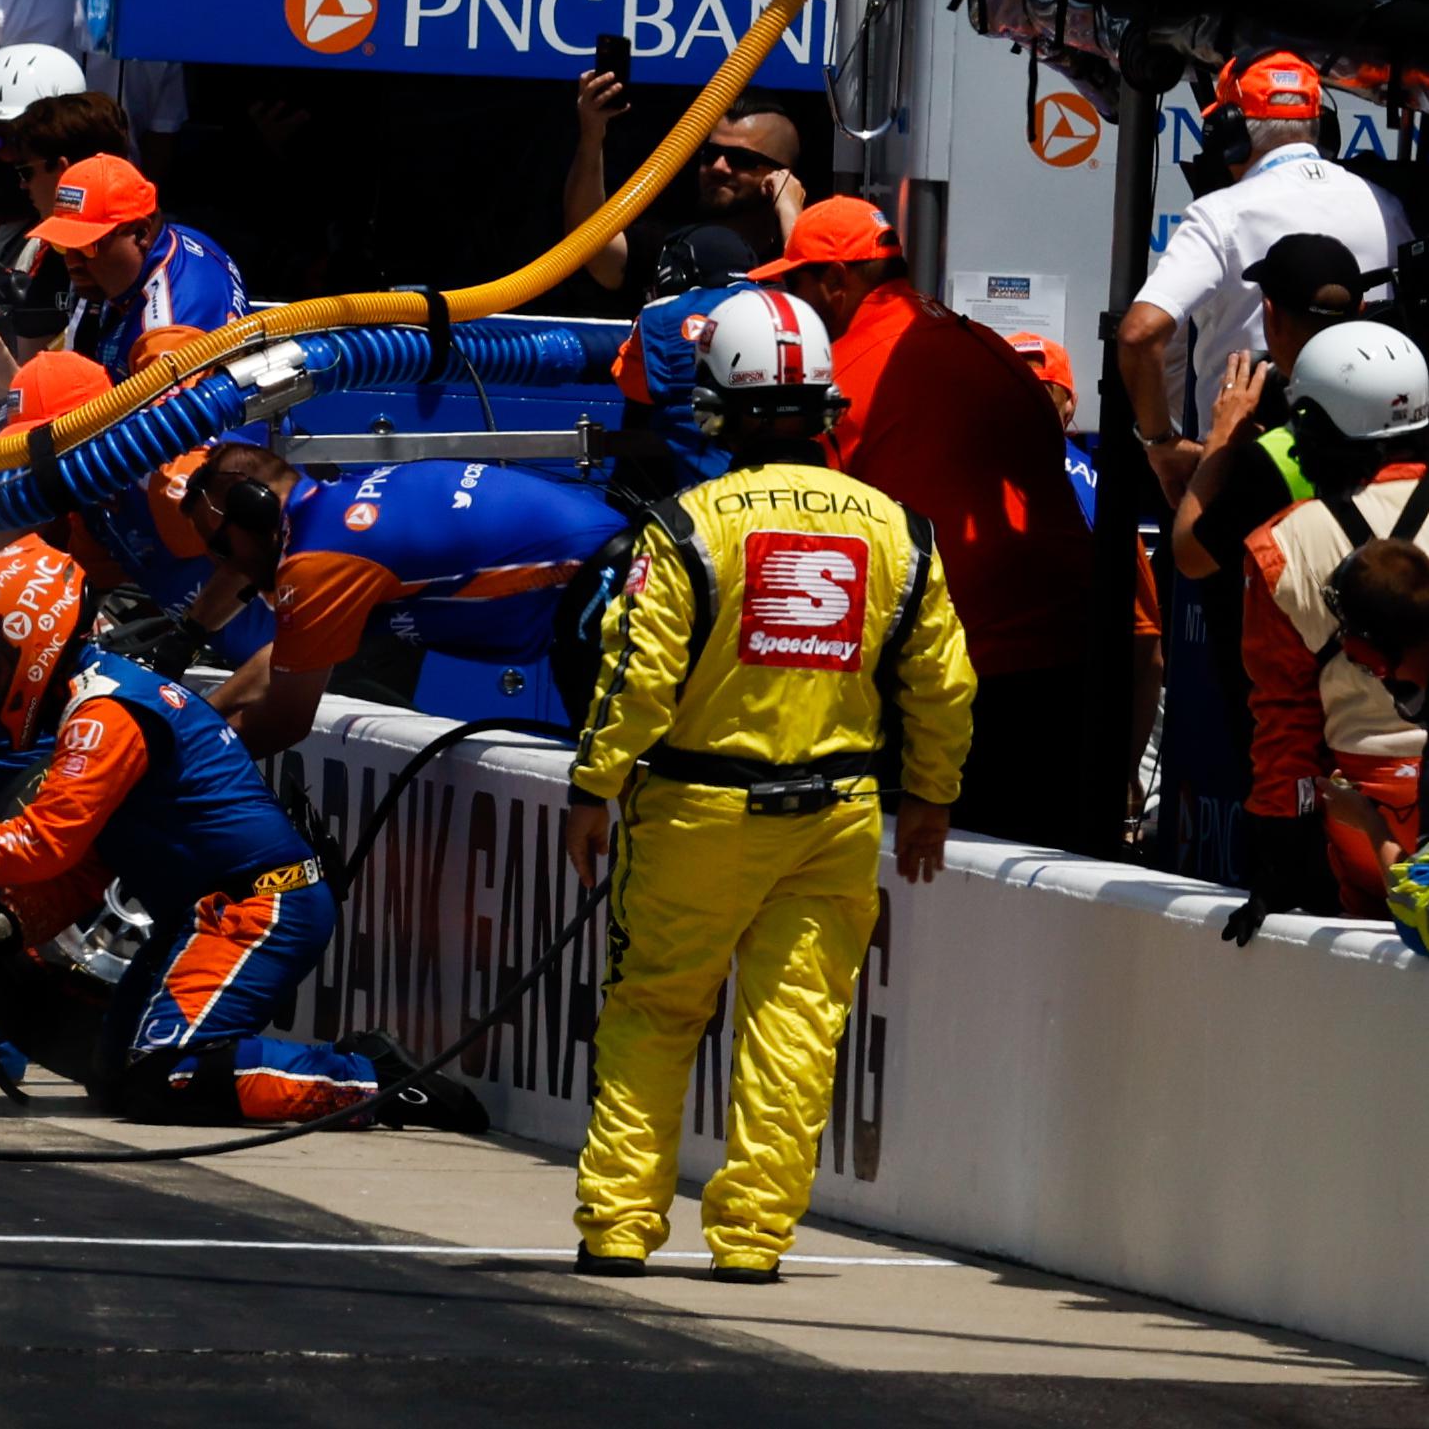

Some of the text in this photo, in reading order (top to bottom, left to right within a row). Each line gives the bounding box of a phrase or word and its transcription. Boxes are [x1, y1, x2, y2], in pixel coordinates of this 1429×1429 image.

[730, 370, 766, 385] SIMPSON
[714, 489, 888, 525] OFFICIAL
[17, 556, 63, 611] PNC
[50, 584, 81, 618] PNC
[40, 633, 68, 667] PNC
[749, 630, 858, 661] Speedway
